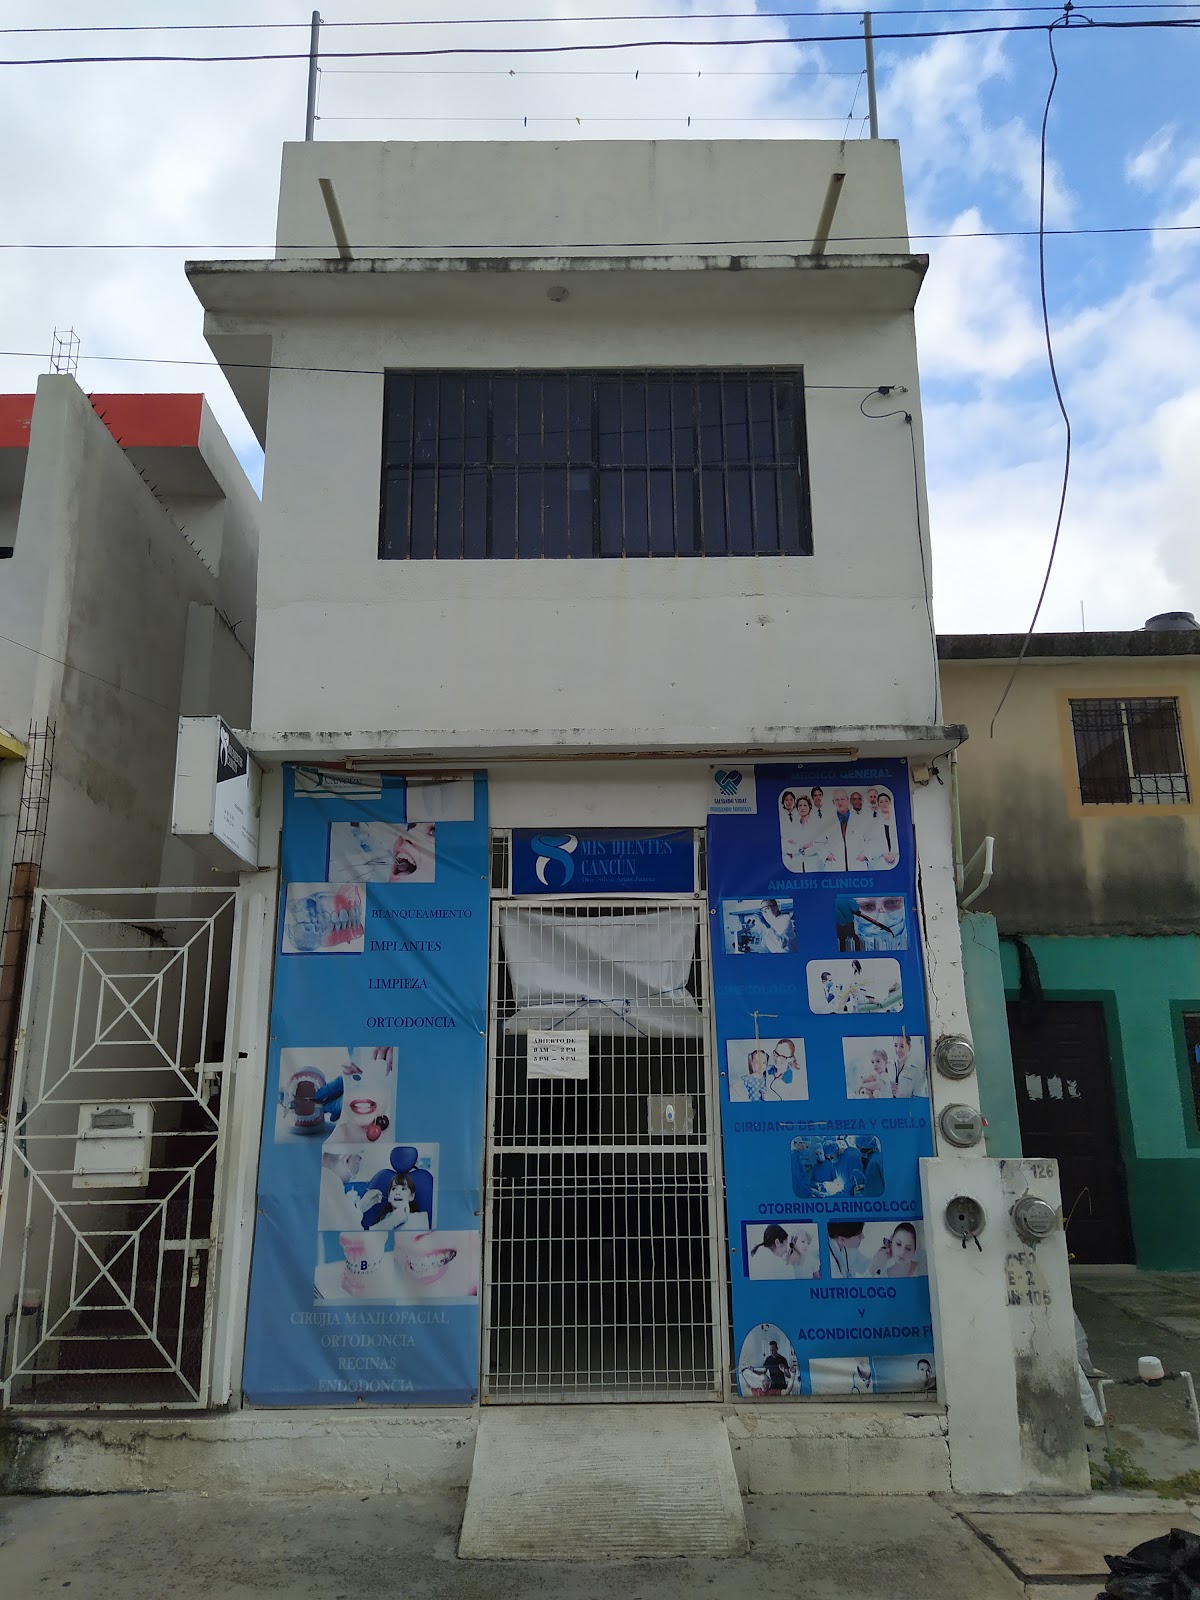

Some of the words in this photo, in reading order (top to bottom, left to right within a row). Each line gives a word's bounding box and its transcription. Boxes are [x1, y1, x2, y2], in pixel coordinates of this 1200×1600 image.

[840, 768, 893, 779] GENERAL
[580, 840, 606, 856] MIS
[612, 838, 673, 855] DIENTES
[581, 855, 636, 876] CANCÚN
[767, 879, 818, 890] ANALISIS
[821, 877, 874, 889] CLINICOS
[371, 909, 472, 919] BLANQUEAMIENTO
[370, 940, 442, 952] IMPLANTES
[368, 978, 428, 989] LIMPIEZA
[366, 1016, 456, 1028] ORTODONCIA
[733, 1120, 795, 1133] CIRUJANO
[797, 1120, 815, 1132] DE
[817, 1119, 865, 1131] CABEZA
[866, 1119, 877, 1130] Y
[881, 1117, 926, 1129] CUELLO
[1030, 1164, 1054, 1179] 126
[757, 1200, 916, 1215] OTORRINOLARINGOLOGO
[360, 1260, 368, 1271] B
[809, 1286, 897, 1299] NUTRIOLOGO
[290, 1311, 341, 1326] CIRUJIA
[344, 1311, 449, 1325] MAXILOFACIAL
[857, 1308, 866, 1318] Y
[798, 1326, 920, 1341] ACONDICIONADOR
[321, 1334, 416, 1348] ORTODONCIA
[338, 1356, 397, 1370] RECINAS
[317, 1379, 414, 1393] ENDODONCIA
